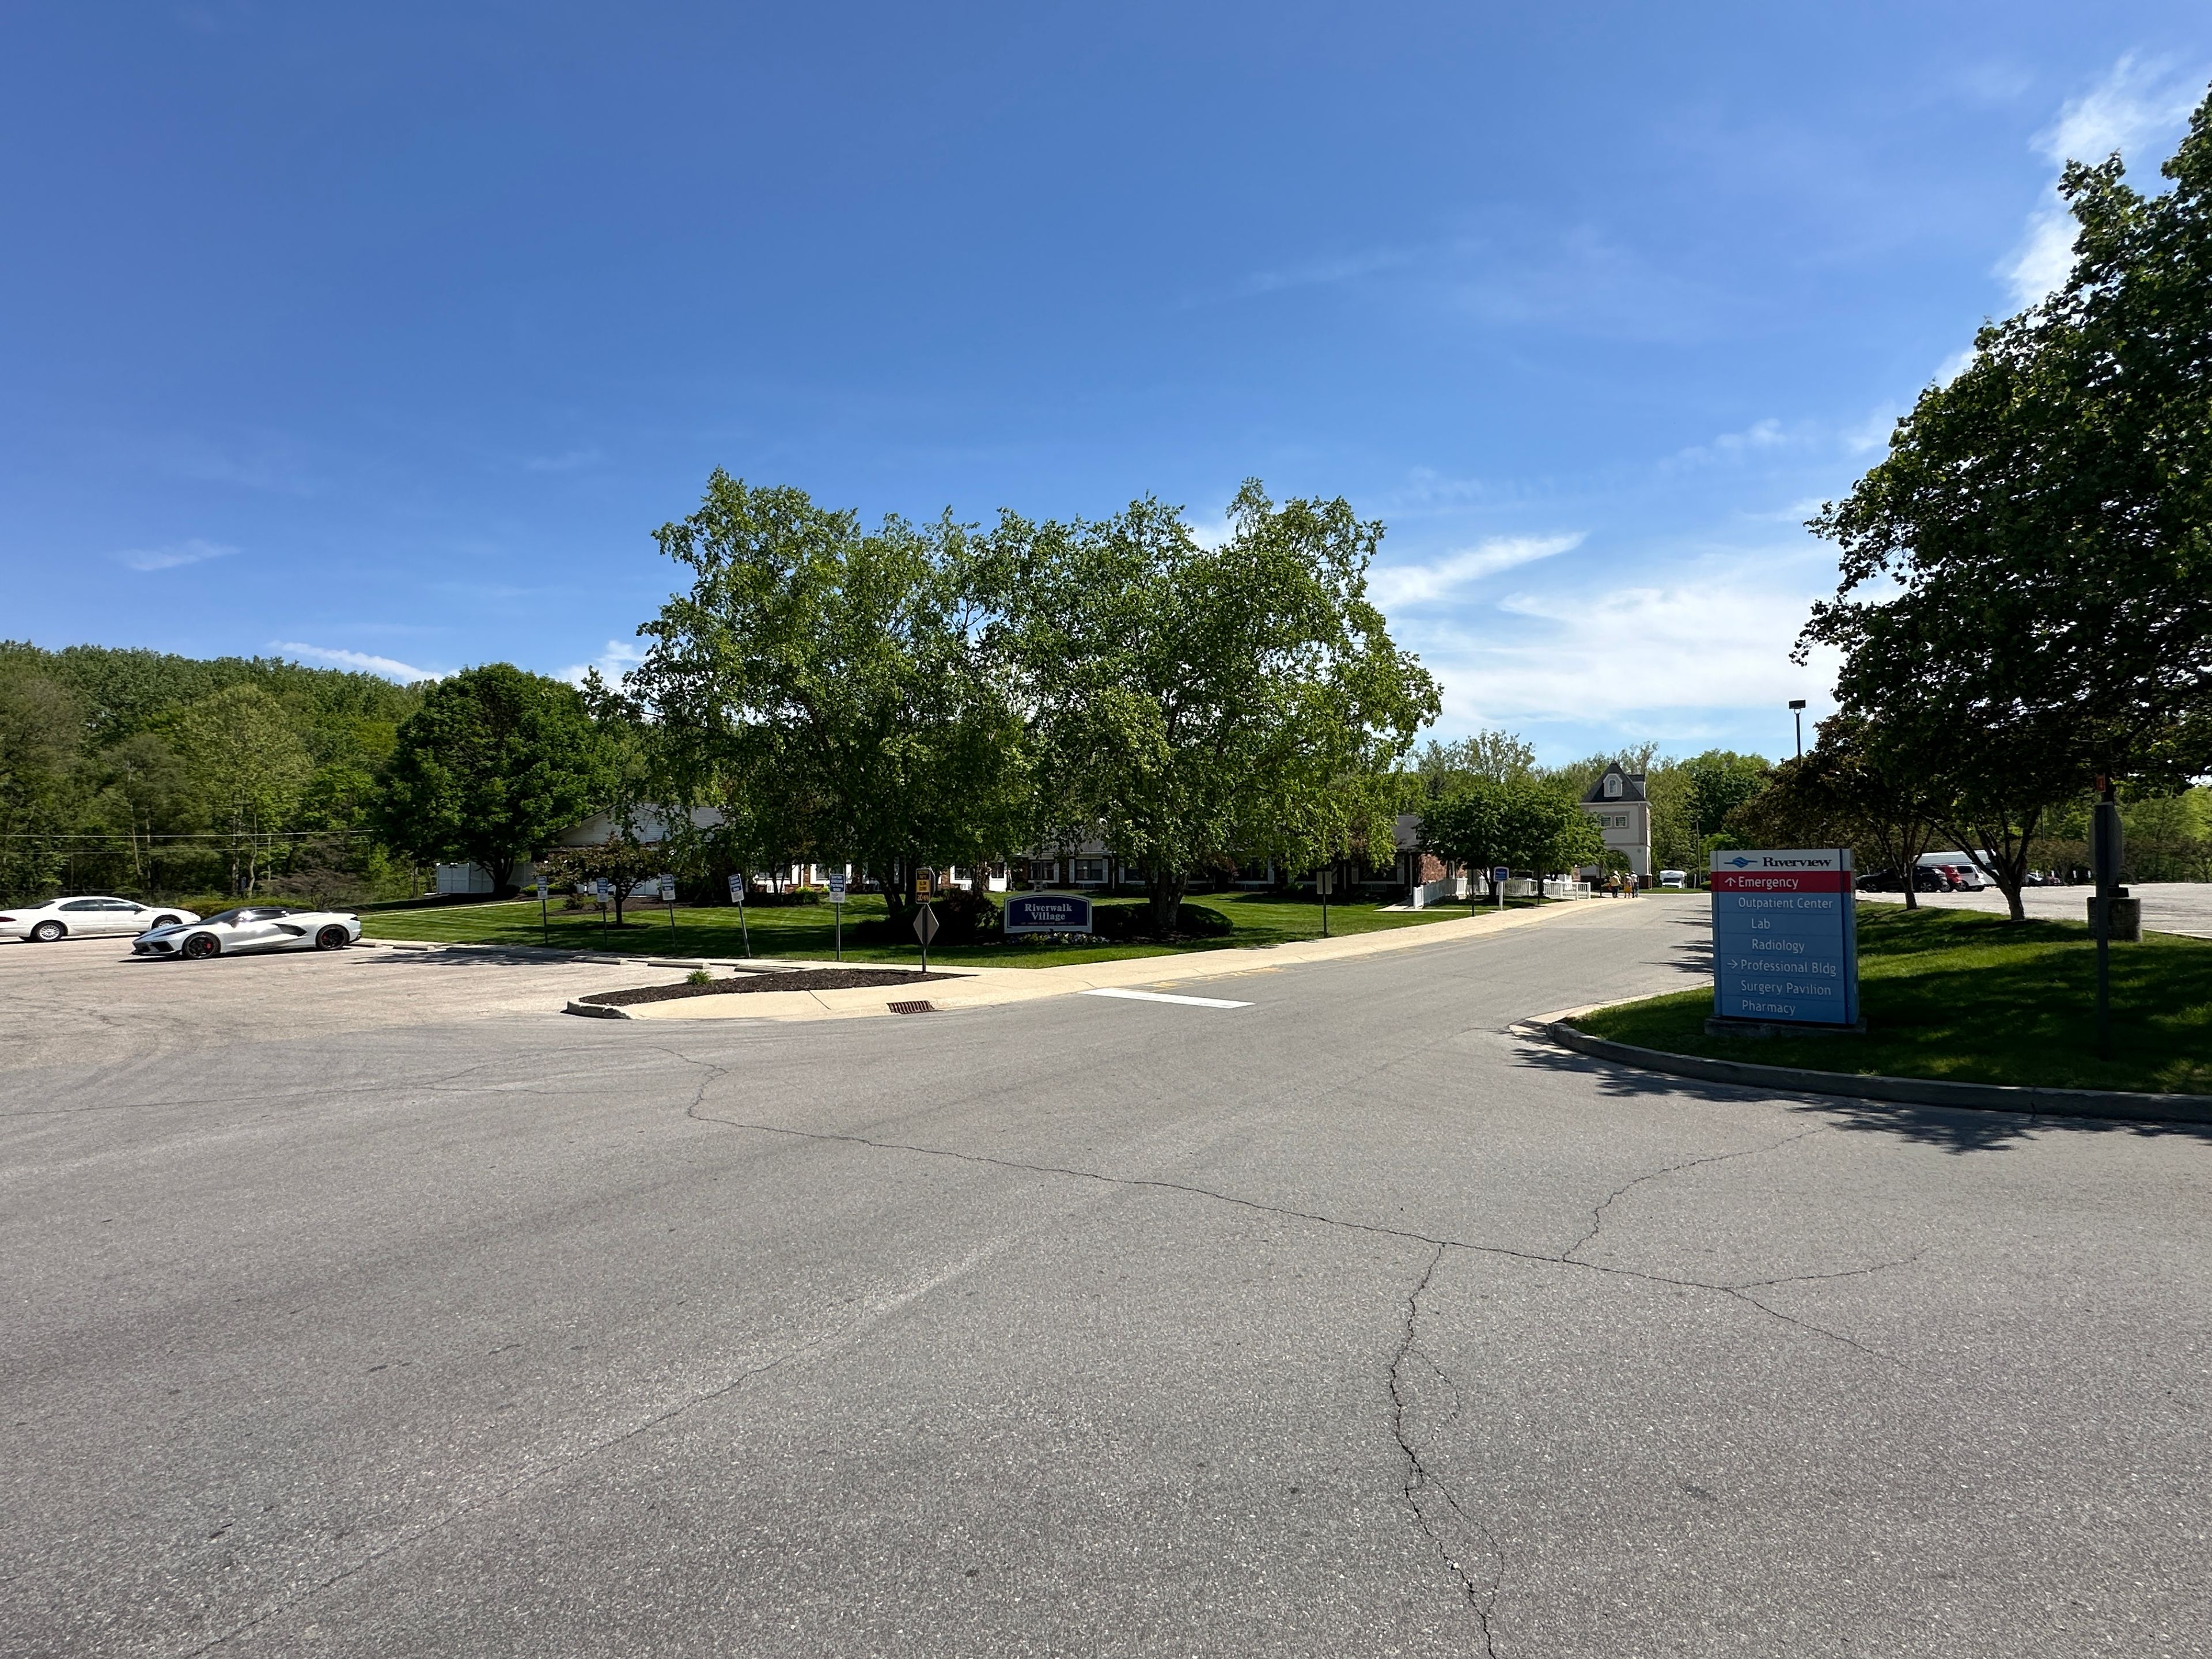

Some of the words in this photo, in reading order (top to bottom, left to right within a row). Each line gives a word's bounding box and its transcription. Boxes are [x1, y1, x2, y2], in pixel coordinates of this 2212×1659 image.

[1762, 857, 1832, 867] Riverview
[1738, 876, 1799, 890] Emergency
[1024, 903, 1073, 912] Riverwalk
[1738, 897, 1794, 910] Outpatient
[1797, 897, 1833, 908] Center
[1031, 912, 1066, 921] Village
[1751, 918, 1771, 929] Lab
[1752, 938, 1805, 954] Radiology
[1741, 959, 1808, 973] Professional
[1812, 961, 1836, 977] Bldg
[1741, 980, 1783, 995] Surgery
[1786, 982, 1832, 995] Pavilion
[1742, 999, 1796, 1016] Pharmacy
